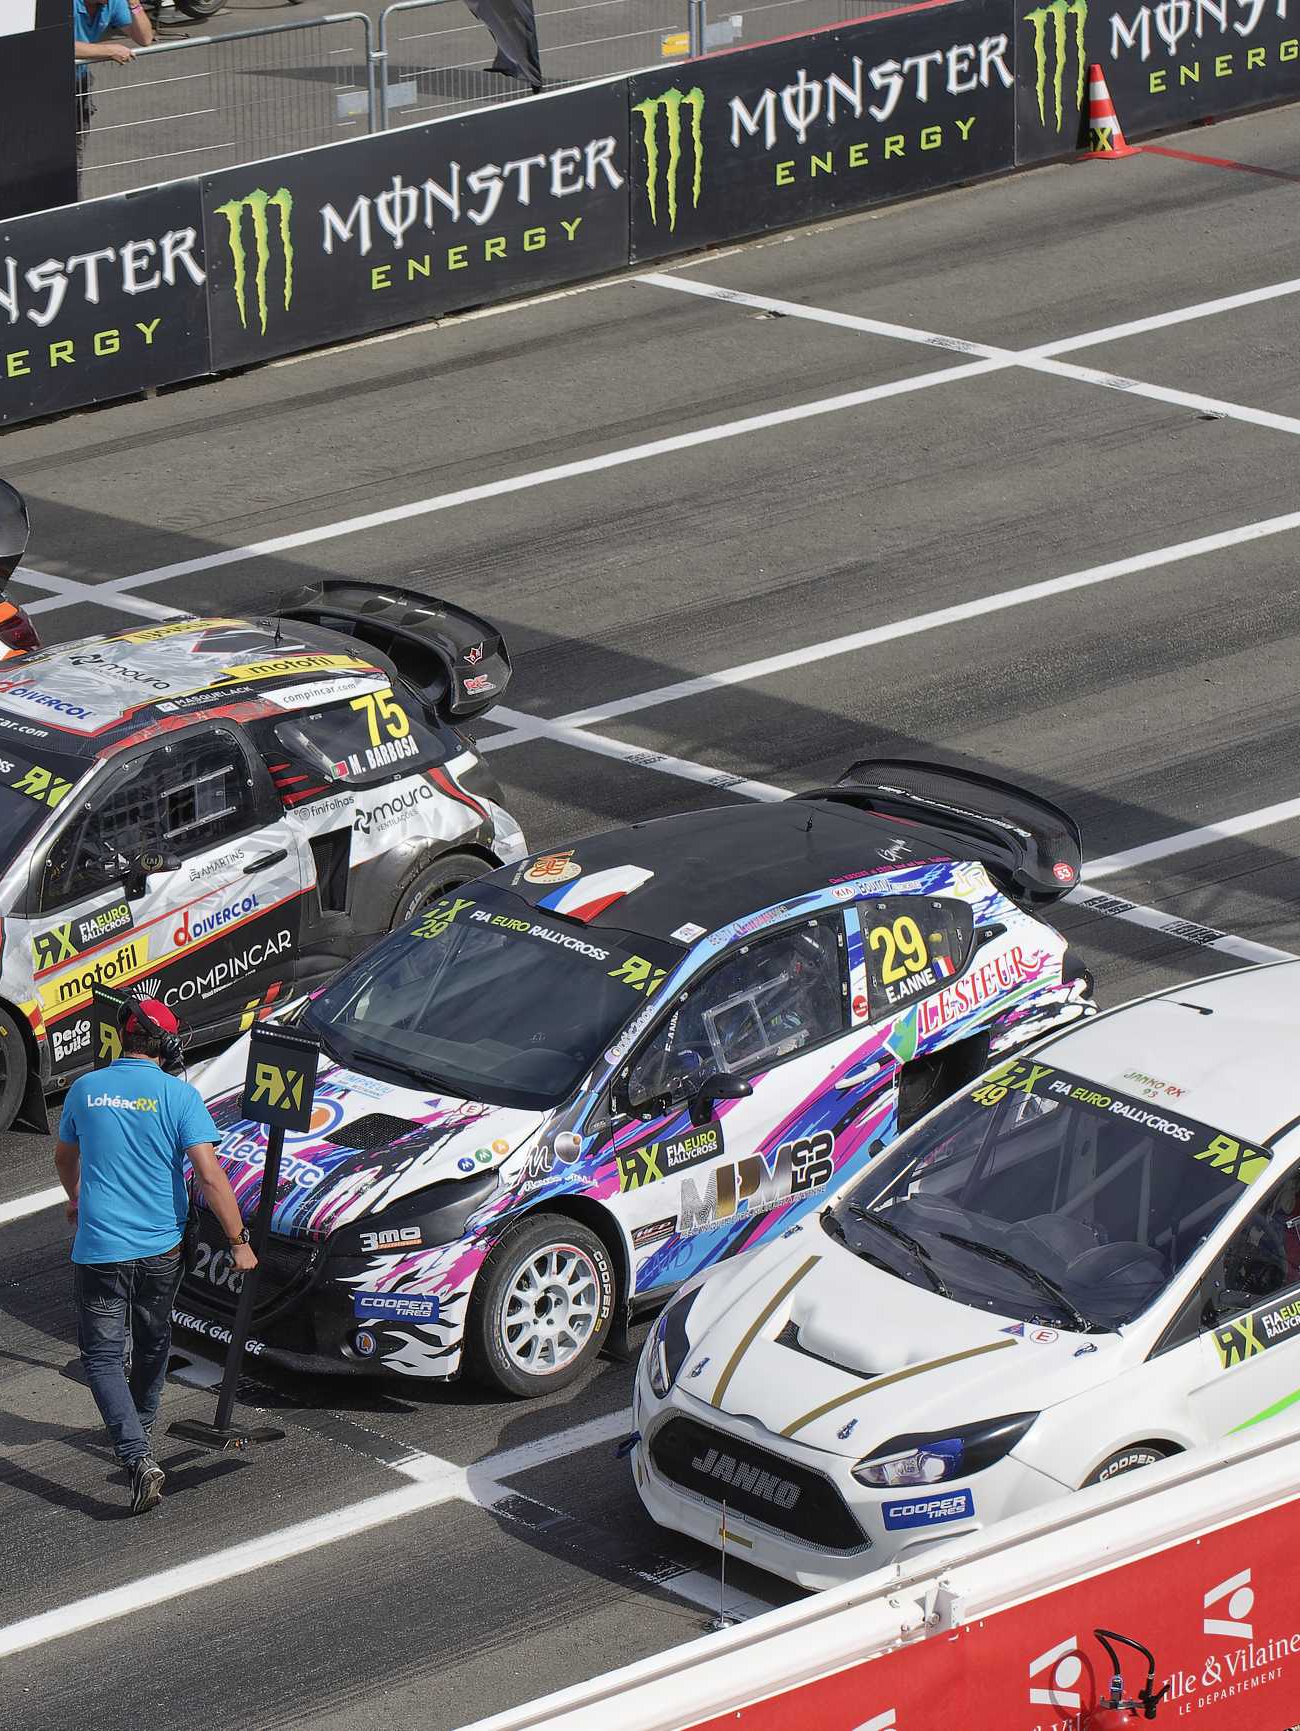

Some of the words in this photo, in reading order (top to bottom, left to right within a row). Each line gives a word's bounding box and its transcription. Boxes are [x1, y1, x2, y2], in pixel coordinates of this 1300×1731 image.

[728, 33, 1014, 150] MONSTER
[775, 116, 978, 187] ENERGY
[319, 135, 625, 256] MONSTER
[372, 217, 582, 290] ENERGY
[103, 662, 171, 690] moura
[247, 655, 333, 675] motofil
[7, 687, 94, 720] DIVERCOL
[282, 681, 357, 704] compincar.com
[350, 688, 410, 747] 75
[348, 754, 367, 775] M.
[365, 735, 419, 770] BARBOSA
[11, 765, 74, 808] RX
[310, 796, 355, 817] finifolhas
[372, 784, 433, 824] moura
[81, 915, 131, 943] RALLYCROSS
[192, 893, 260, 938] DIVERCOL
[410, 920, 449, 939] 29
[31, 920, 79, 970] RX
[469, 910, 491, 924] FIA
[490, 915, 533, 932] EURO
[528, 925, 610, 961] RALLYCROSS
[607, 954, 668, 997] RX
[869, 916, 928, 985] 29
[59, 944, 138, 1000] motofil
[164, 929, 292, 1008] COMPINCAR
[885, 966, 936, 1004] E.ANNE
[921, 946, 1040, 1035] LESIEUR
[54, 1032, 91, 1062] Build
[87, 1094, 158, 1112] LohéacRX
[251, 1063, 305, 1111] RX
[970, 1083, 1008, 1107] 49
[1122, 1071, 1166, 1091] JANKO
[1163, 1085, 1186, 1098] RX
[1049, 1080, 1072, 1095] FIA
[1070, 1086, 1112, 1108] EURO
[1107, 1100, 1195, 1143] RALLYCROSS
[1193, 1134, 1271, 1186] RX
[616, 1143, 665, 1194] RX
[667, 1141, 718, 1168] RALLYCROSS
[361, 1297, 434, 1310] COOPER
[593, 1251, 612, 1319] COOPER
[395, 1308, 432, 1317] TIRES
[1211, 1314, 1265, 1370] RX
[691, 1447, 802, 1510] JANKO
[1100, 1454, 1156, 1481] COOPER
[889, 1495, 967, 1519] COOPER
[927, 1505, 967, 1521] TIRES
[1200, 1655, 1222, 1688] &
[1179, 1700, 1192, 1716] LE
[1198, 1668, 1285, 1708] DEPARTEMENT
